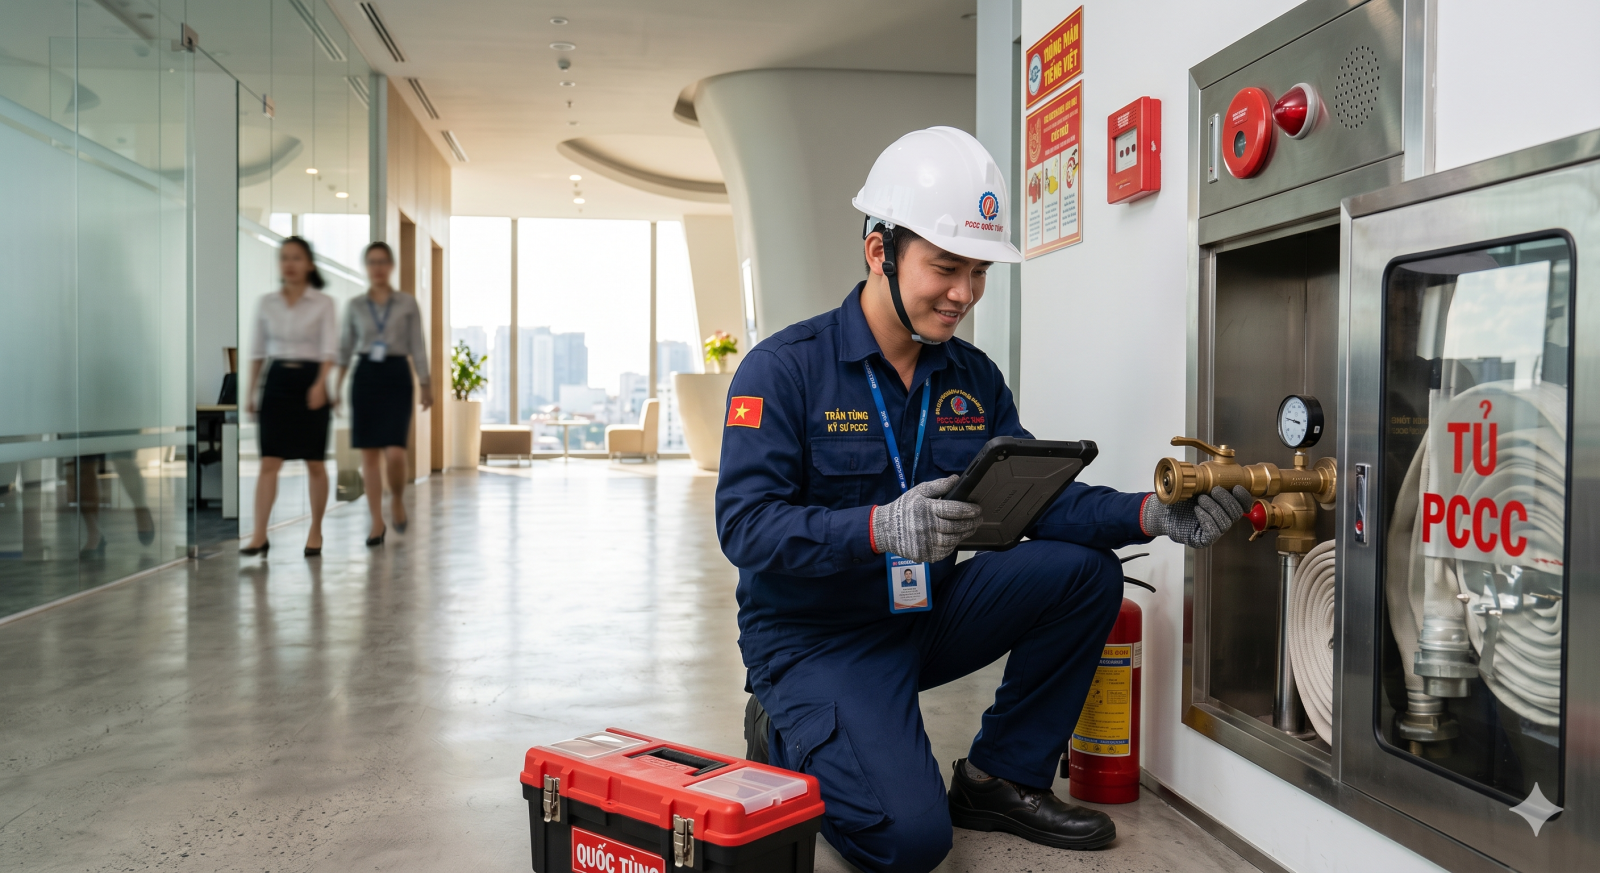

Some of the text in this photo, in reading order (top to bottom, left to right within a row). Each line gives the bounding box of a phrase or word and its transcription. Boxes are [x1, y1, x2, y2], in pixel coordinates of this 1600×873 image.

[1063, 48, 1078, 73] VIỆT
[964, 220, 980, 229] PCCC
[839, 422, 850, 432] SƯ
[850, 423, 869, 432] PCCC
[847, 409, 869, 420] TÙNG
[1447, 400, 1498, 476] TỦ
[1422, 492, 1528, 557] PCCC
[576, 842, 615, 873] QUỐC
